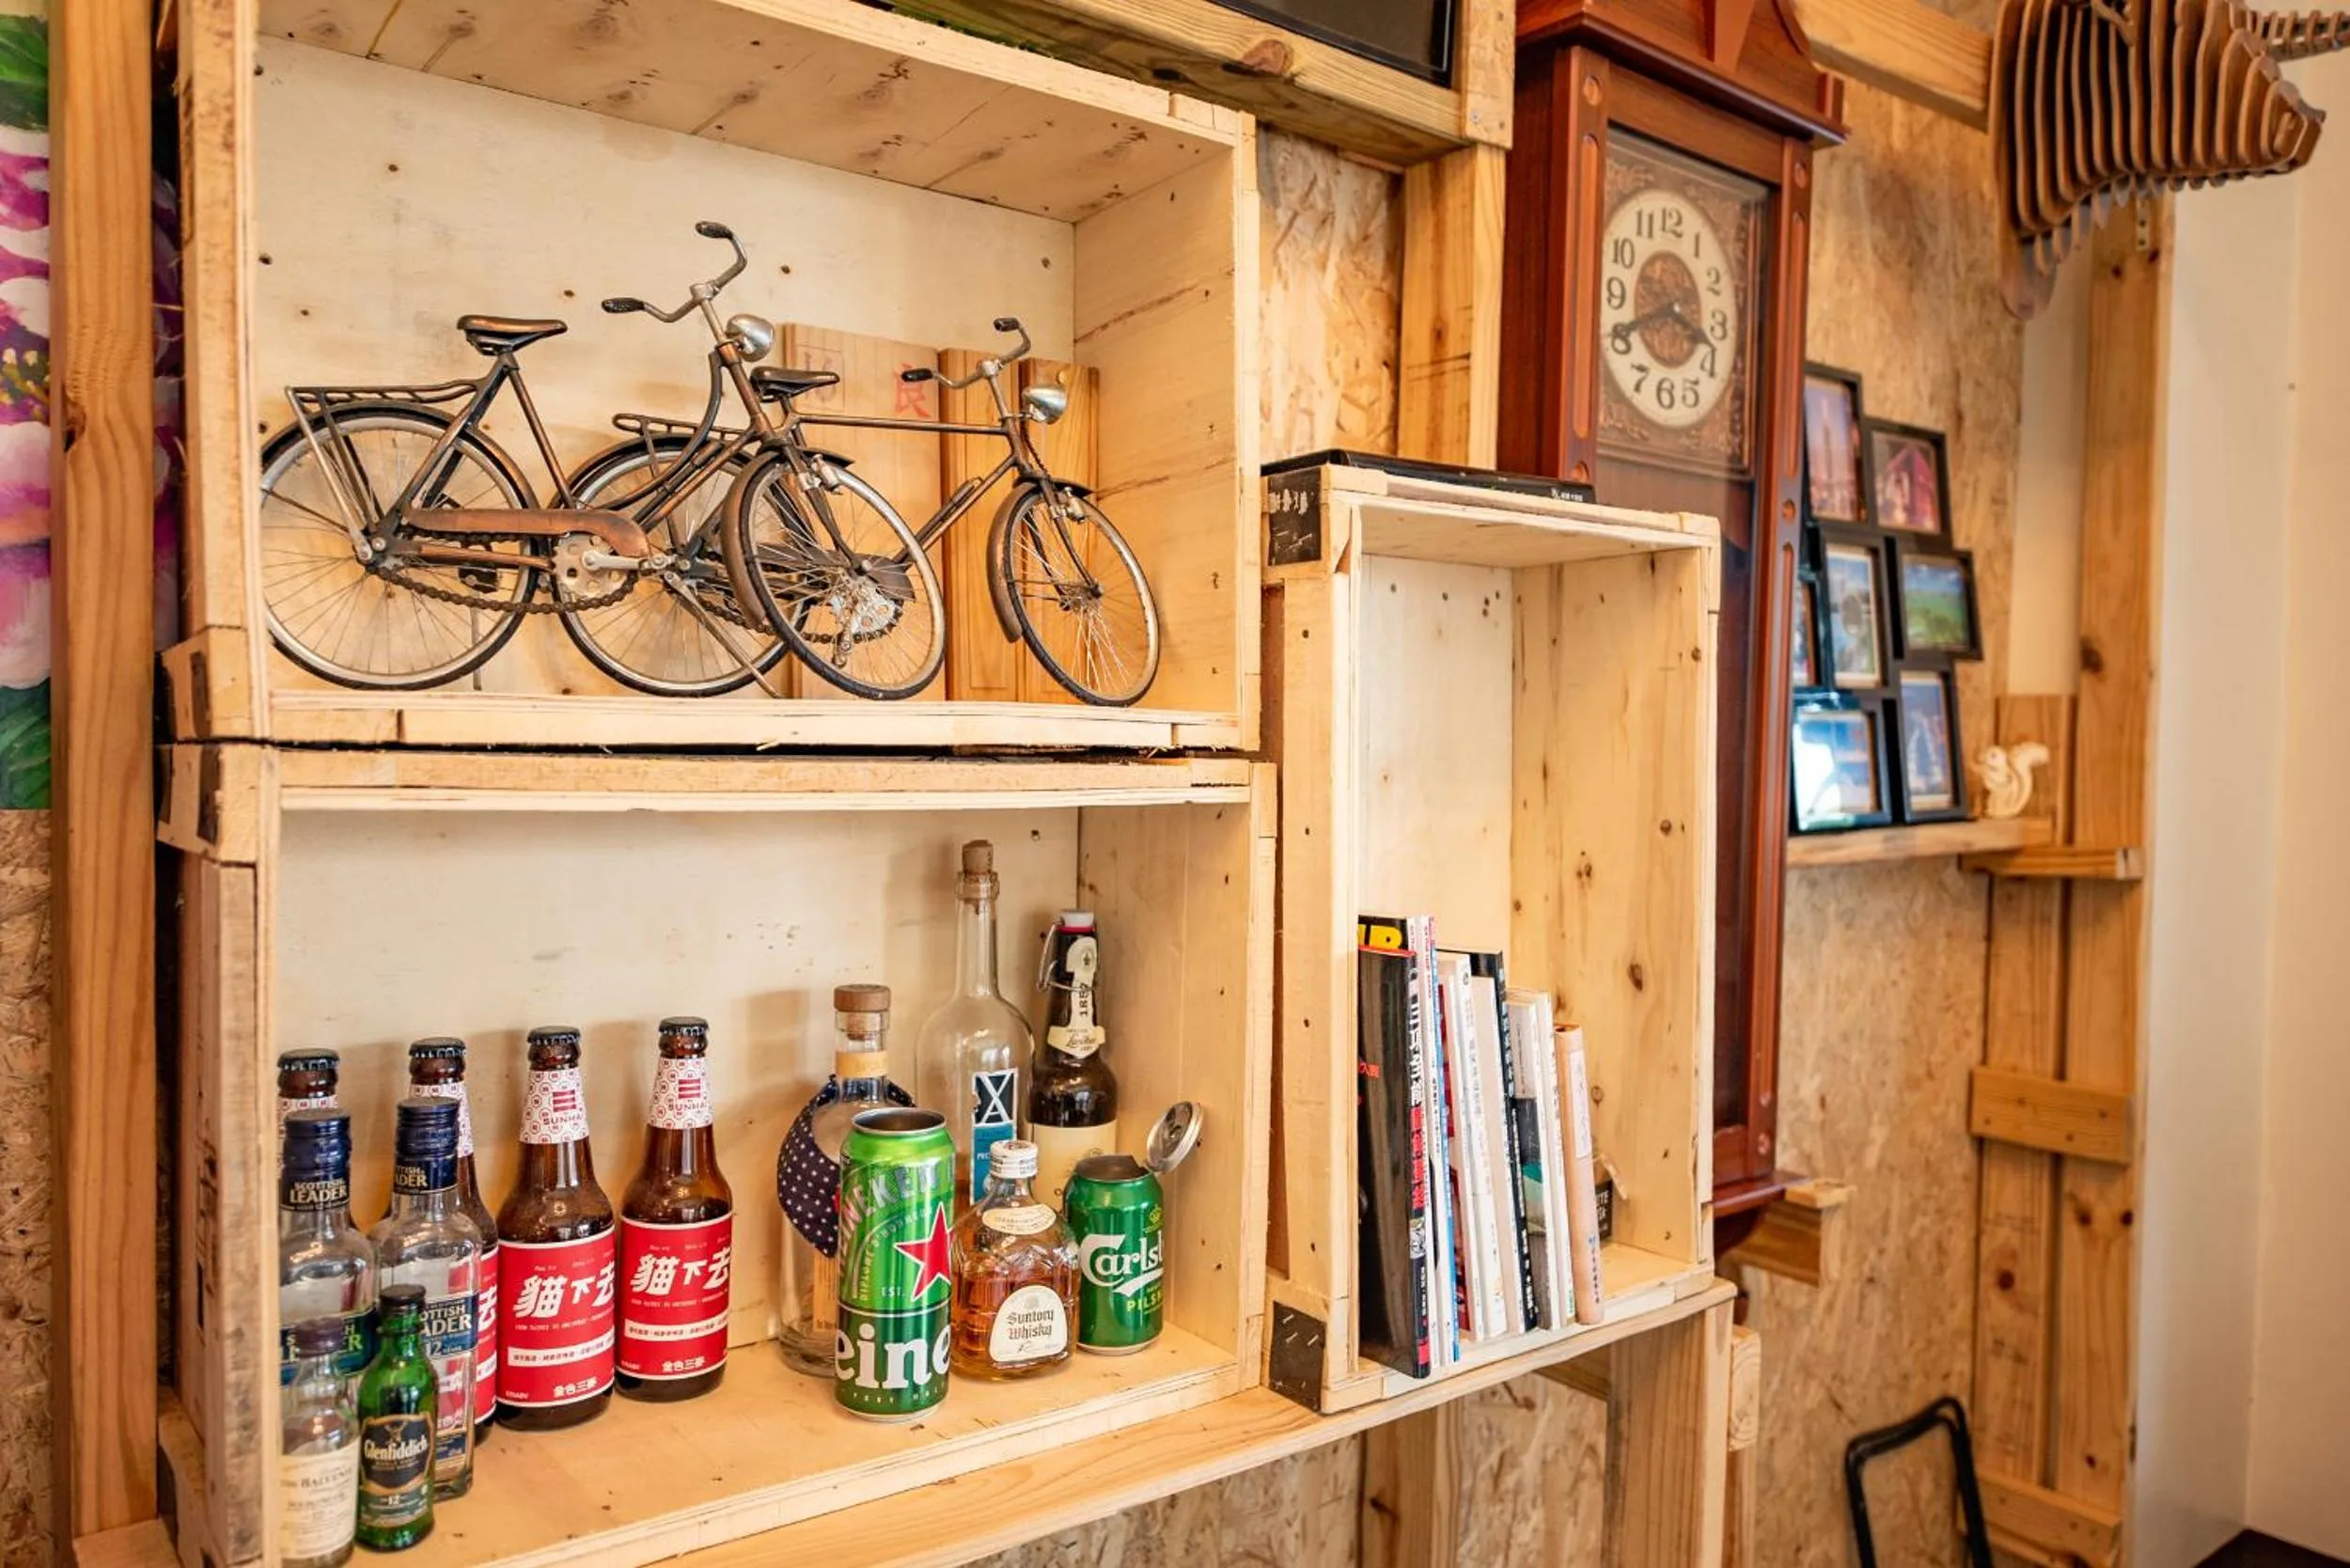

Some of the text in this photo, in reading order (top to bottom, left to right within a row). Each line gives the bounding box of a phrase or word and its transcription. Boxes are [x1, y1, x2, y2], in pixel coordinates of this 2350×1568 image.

[1637, 208, 1654, 239] 11
[1660, 206, 1684, 239] 12
[1612, 238, 1635, 269] 10
[1694, 230, 1700, 259] 1
[1606, 276, 1626, 310] 9
[1707, 267, 1721, 297] 2
[1610, 322, 1632, 355] 8
[1710, 309, 1728, 340] 3
[1700, 345, 1716, 378] 4
[1631, 363, 1649, 394] 7
[1656, 378, 1675, 410] 6
[1683, 378, 1700, 409] 5
[290, 1185, 347, 1204] LEADER
[420, 1313, 472, 1338] ADER
[421, 1305, 465, 1321] OTTISH
[1007, 1309, 1054, 1325] Suntory
[1007, 1324, 1052, 1341] Whisky
[364, 1435, 428, 1461] Glenfiddich
